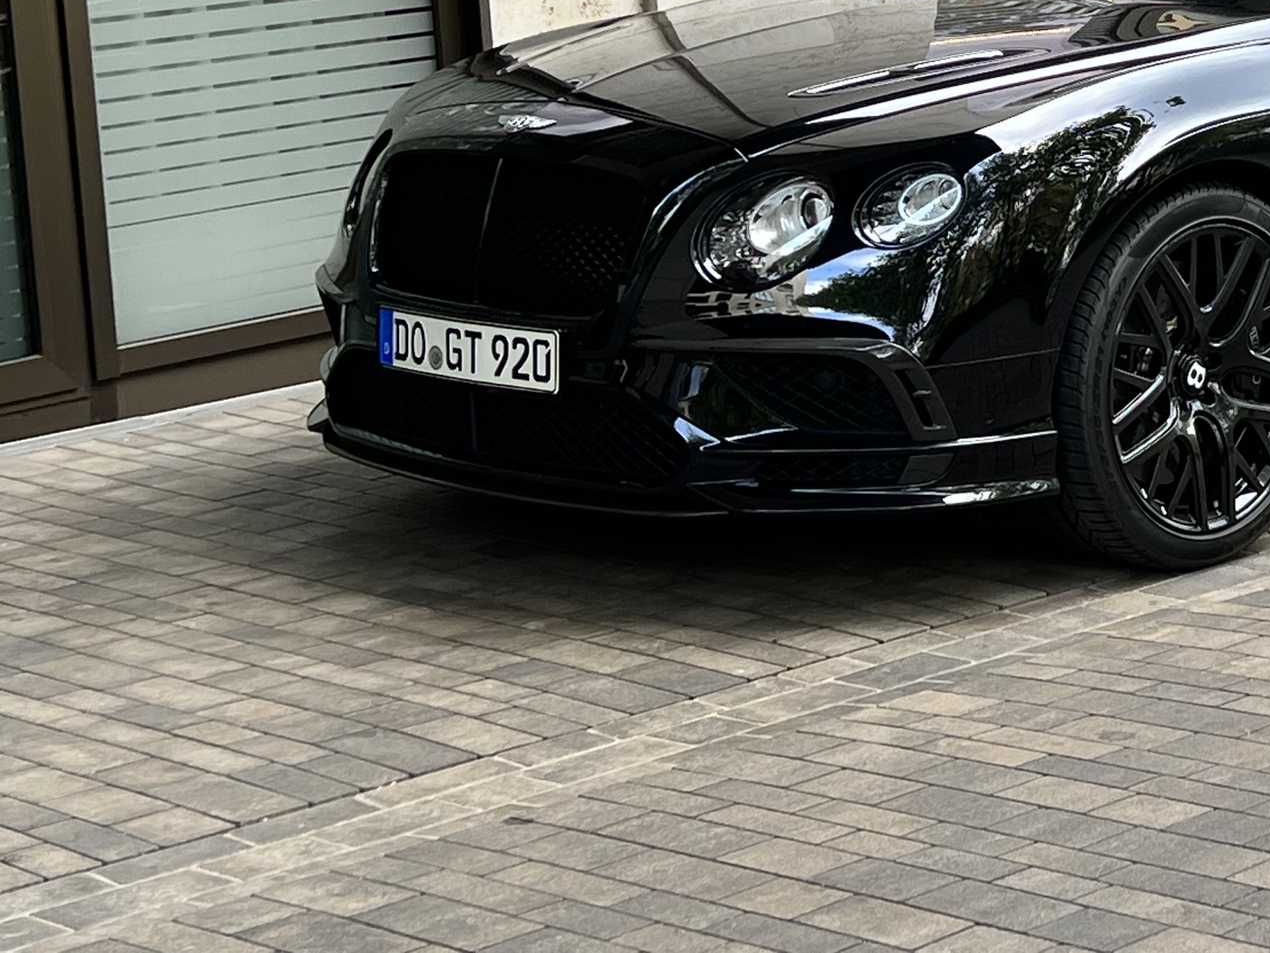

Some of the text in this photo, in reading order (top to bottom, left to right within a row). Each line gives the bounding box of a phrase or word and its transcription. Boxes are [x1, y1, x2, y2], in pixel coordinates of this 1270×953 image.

[395, 318, 552, 383] DO GT 920
